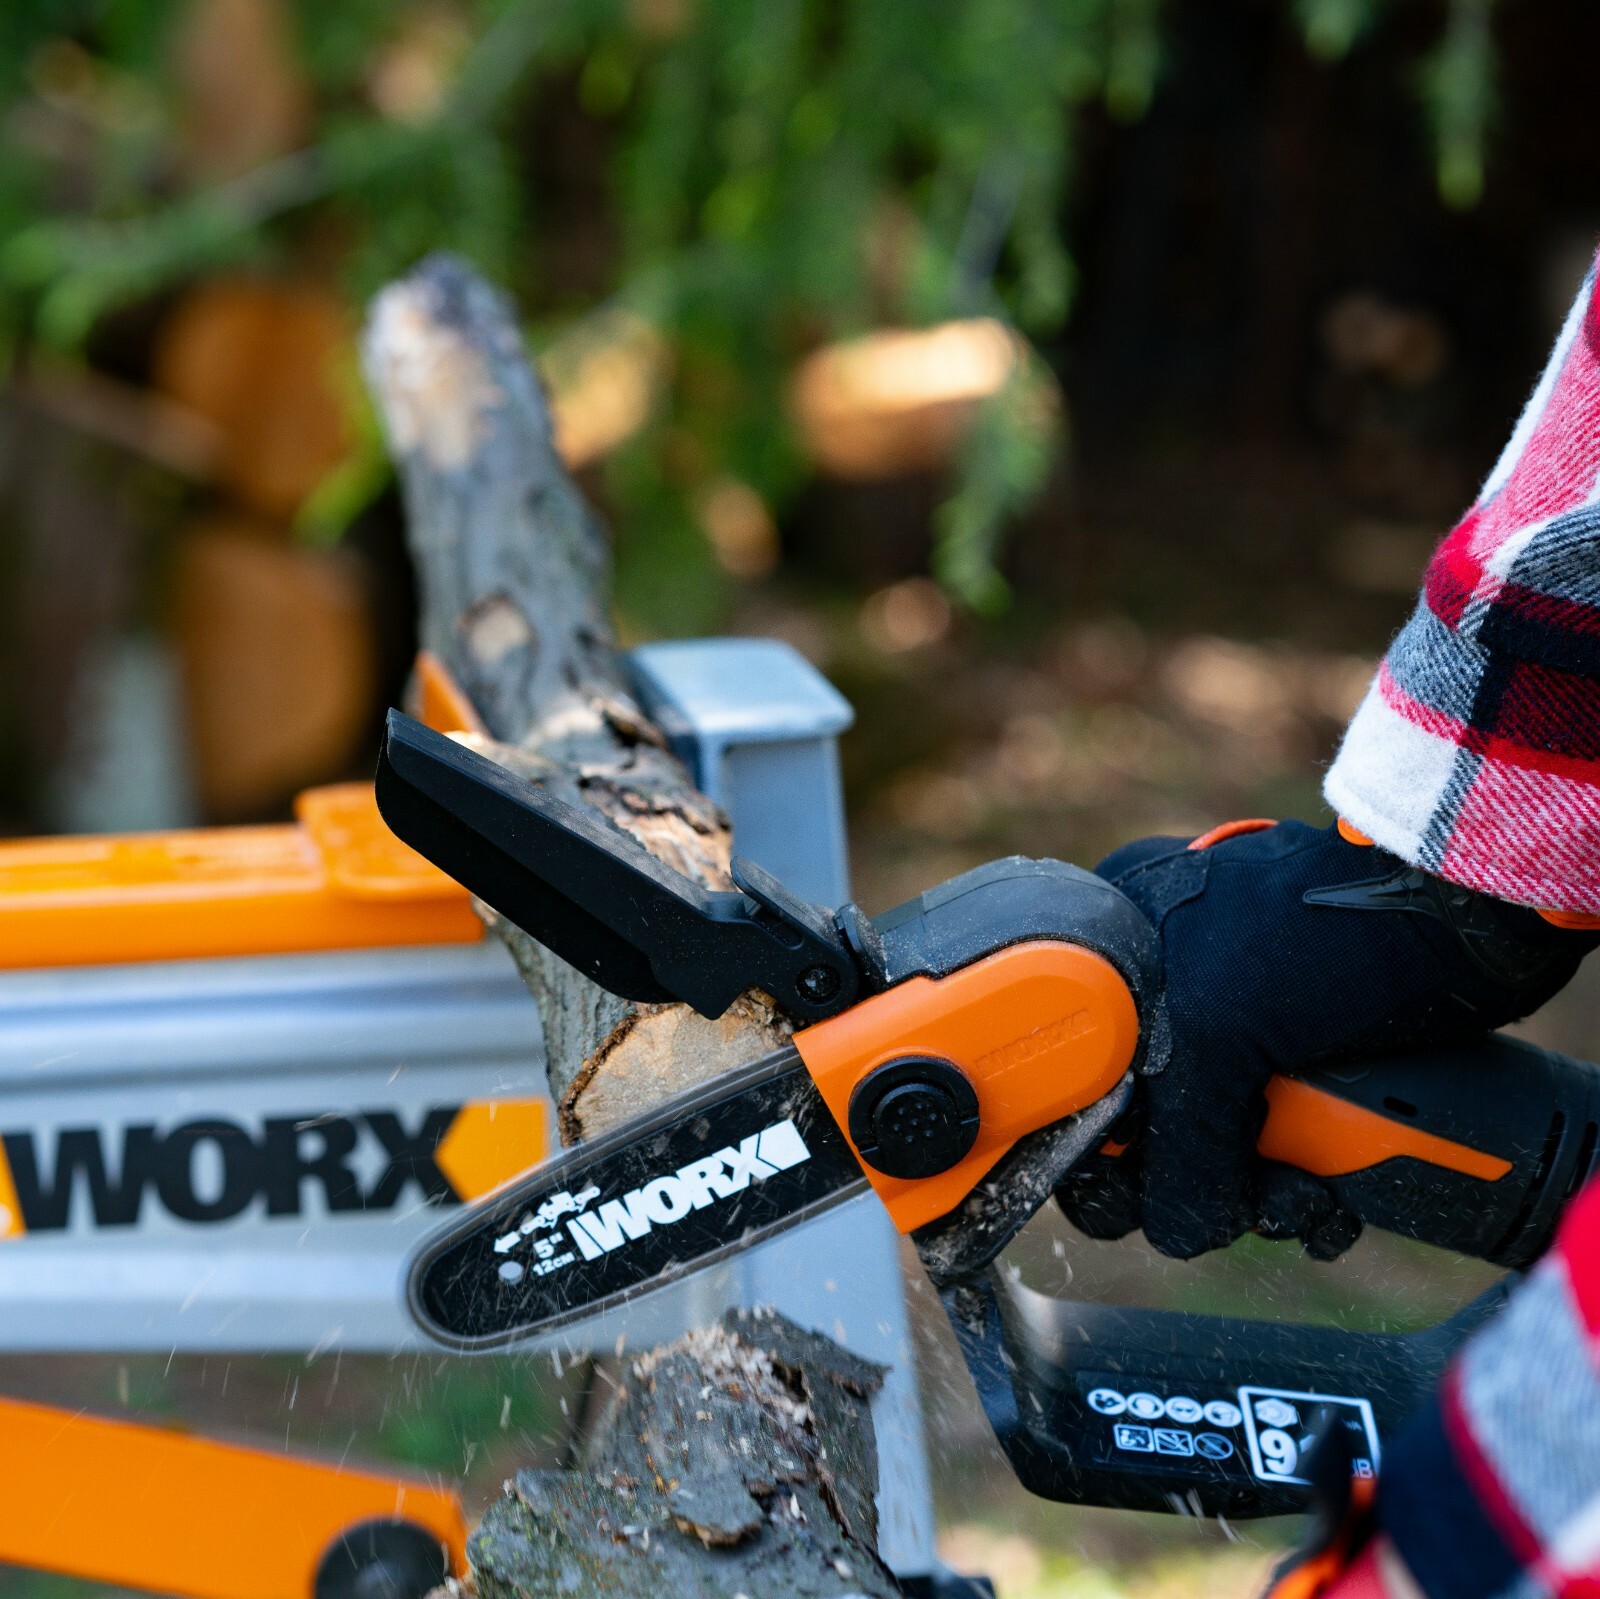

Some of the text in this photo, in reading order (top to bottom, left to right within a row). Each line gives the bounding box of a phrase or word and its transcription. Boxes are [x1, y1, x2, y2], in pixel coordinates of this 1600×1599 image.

[4, 1108, 462, 1230] WORX
[576, 1132, 782, 1256] WORX
[533, 1231, 564, 1259] 5"
